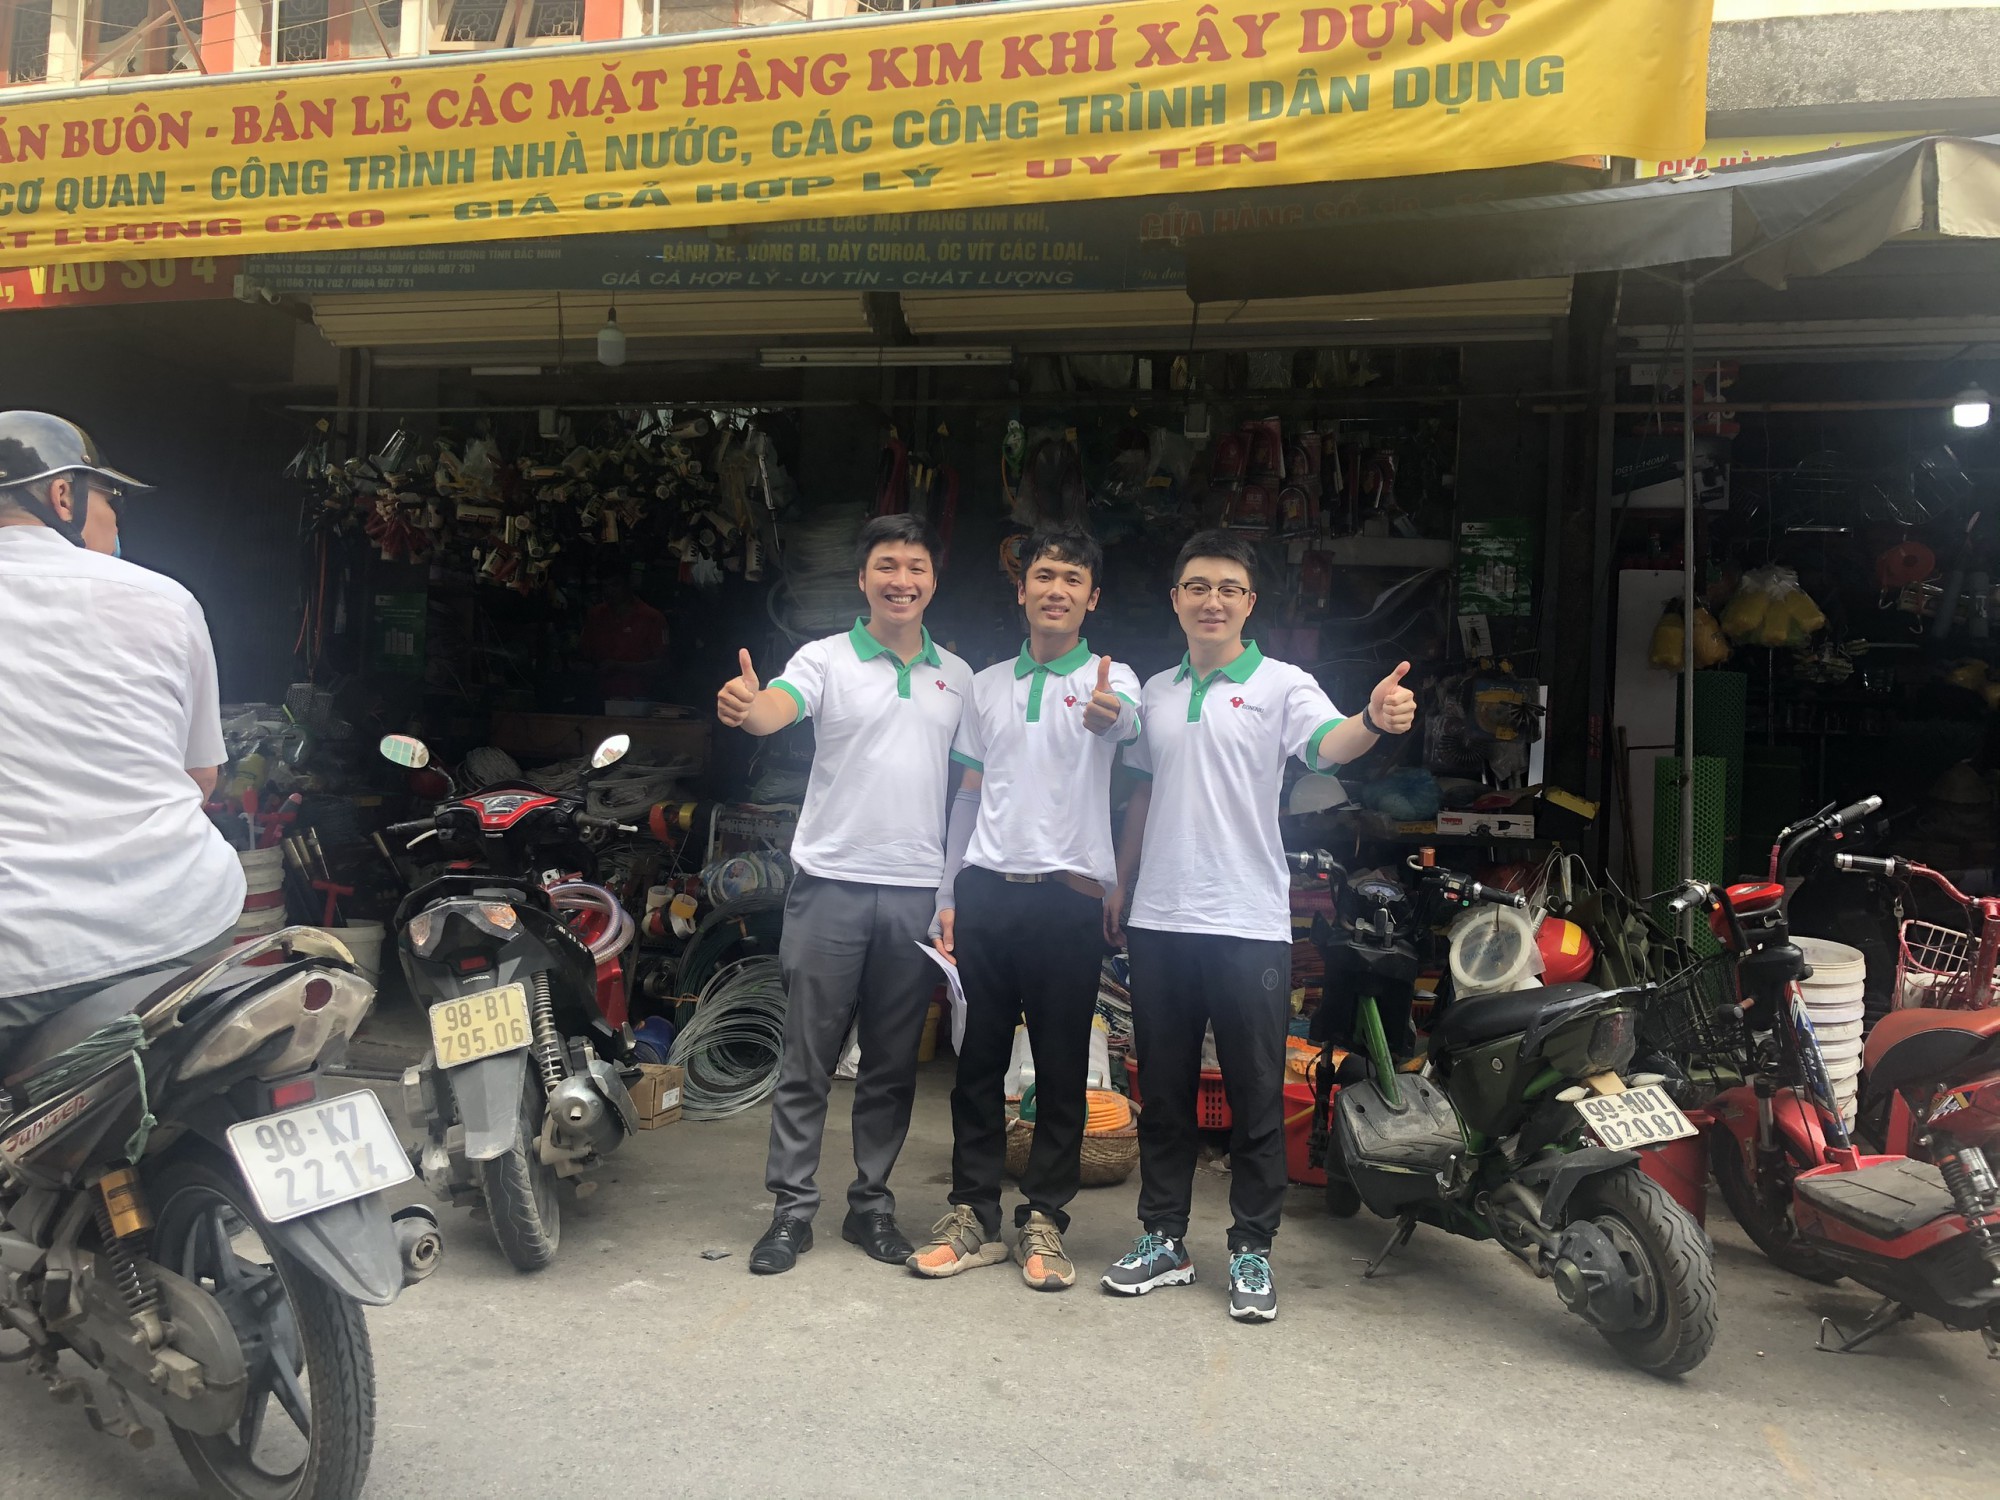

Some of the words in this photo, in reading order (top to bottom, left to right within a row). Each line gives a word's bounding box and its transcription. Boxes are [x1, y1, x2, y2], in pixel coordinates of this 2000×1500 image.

[61, 102, 193, 159] BUÔN
[231, 90, 336, 145] BÁN
[351, 78, 412, 136] LẺ
[426, 73, 533, 129] CÁC
[548, 61, 667, 124] MẶT
[681, 48, 851, 109] HÀNG
[867, 40, 984, 91] KIM
[1001, 13, 1118, 80] KHÍ
[1135, 4, 1280, 69] XÂY
[55, 171, 166, 215] QUAN
[210, 156, 328, 201] CÔNG
[343, 145, 475, 192] TRÌNH
[492, 131, 588, 181] NHÀ
[604, 117, 753, 173] NƯỚC,
[770, 109, 872, 159] CÁC
[891, 98, 1038, 149] CÔNG
[1058, 80, 1226, 136] TRÌNH
[1247, 68, 1370, 123] DÂN
[1392, 55, 1565, 115] DỤNG
[54, 216, 243, 248] LƯỢNG
[264, 208, 386, 234] CAO
[454, 193, 560, 221] GIÁ
[584, 179, 671, 212] CẢ
[695, 174, 836, 205] HỢP
[862, 166, 943, 191] LÝ
[1025, 153, 1122, 179] UY
[1148, 141, 1277, 171] TÍN
[972, 212, 1008, 231] KIM
[748, 240, 794, 262] VÒNG
[828, 240, 862, 262] DÂY
[967, 238, 994, 261] VÍT
[1000, 238, 1036, 261] CÁC
[601, 270, 641, 285] GIÁ
[689, 271, 743, 288] HỢP
[801, 272, 838, 285] UY
[842, 268, 881, 284] TÍN
[462, 975, 491, 985] HONDA
[445, 992, 511, 1031] 98-B1
[441, 1018, 525, 1061] 795.06
[254, 1101, 360, 1163] 98-K7
[275, 1142, 389, 1209] 2214
